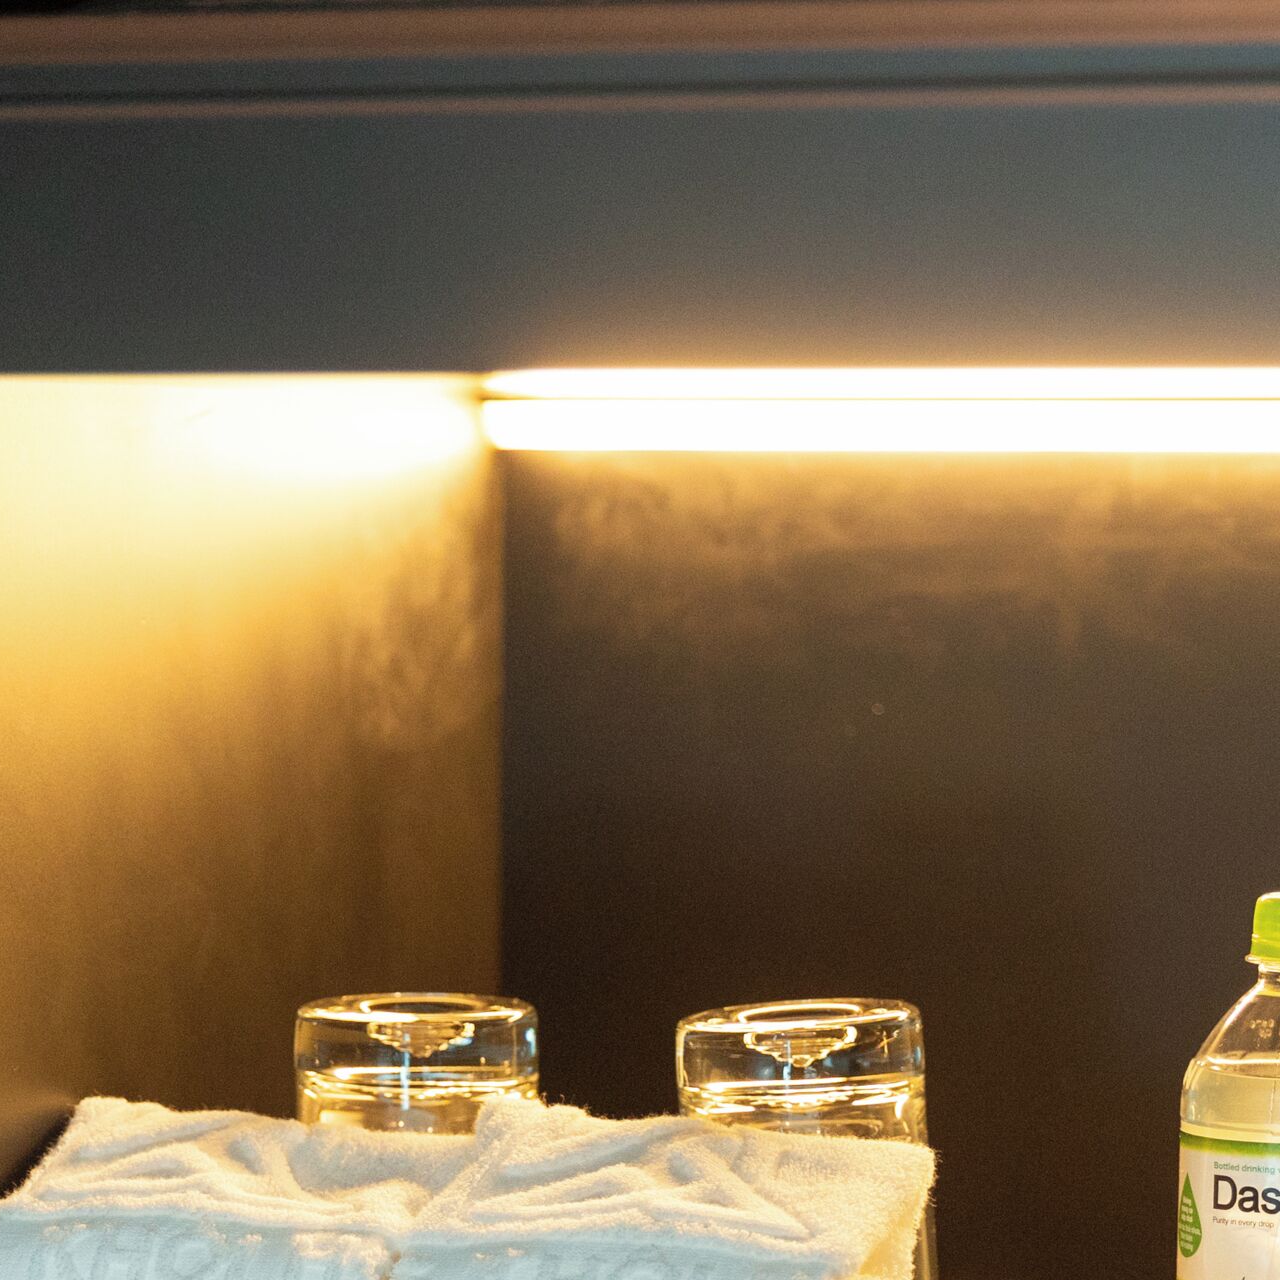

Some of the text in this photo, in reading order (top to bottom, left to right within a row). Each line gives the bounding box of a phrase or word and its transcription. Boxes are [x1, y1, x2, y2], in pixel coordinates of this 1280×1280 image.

[1213, 1161, 1240, 1172] Bottled
[1241, 1164, 1276, 1175] drinking
[1238, 1220, 1256, 1228] every
[1258, 1220, 1275, 1229] drop
